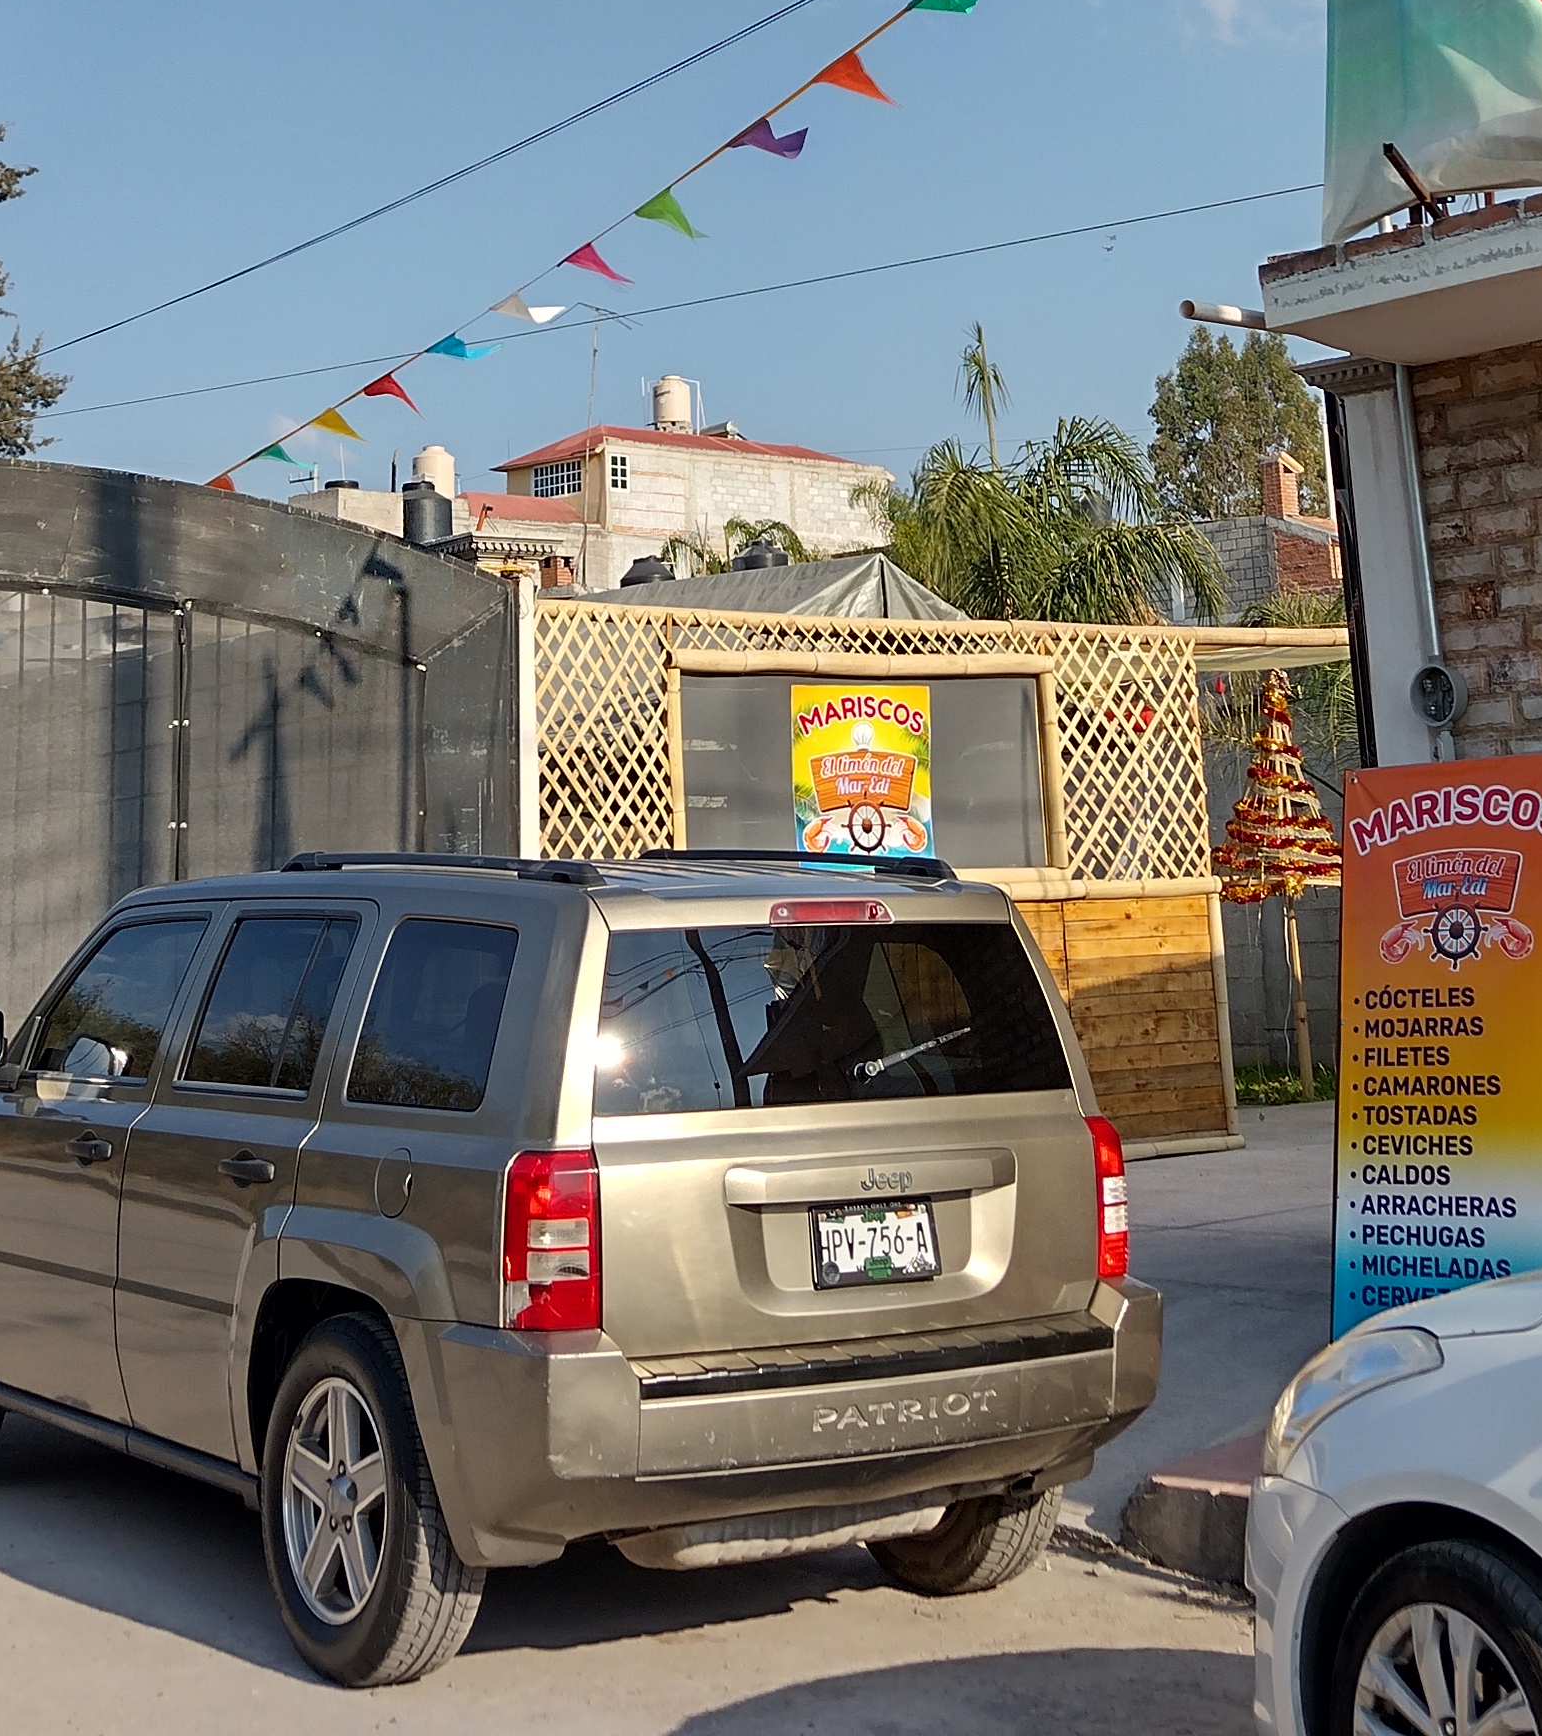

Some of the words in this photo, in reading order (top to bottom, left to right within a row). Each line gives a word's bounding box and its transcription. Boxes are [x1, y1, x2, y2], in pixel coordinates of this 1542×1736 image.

[797, 695, 925, 736] MARISCOS
[820, 756, 836, 778] El
[880, 756, 905, 777] del
[1406, 859, 1423, 883] El
[1475, 855, 1506, 877] del
[1364, 984, 1475, 1010] CÓCTELES
[1364, 1016, 1484, 1039] MOJARRAS
[1364, 1045, 1450, 1067] FILETES
[1363, 1075, 1501, 1096] CAMARONES
[1362, 1105, 1477, 1126] TOSTADAS
[1362, 1135, 1473, 1156] CEVICHES
[860, 1168, 913, 1193] Jeep
[1362, 1164, 1451, 1185] CALDOS
[1360, 1194, 1517, 1218] ARRACHERAS
[820, 1222, 928, 1262] HPV-756-A
[1362, 1224, 1486, 1248] PECHUGAS
[1362, 1254, 1512, 1279] MICHELADAS
[812, 1389, 997, 1432] PATRIOT
